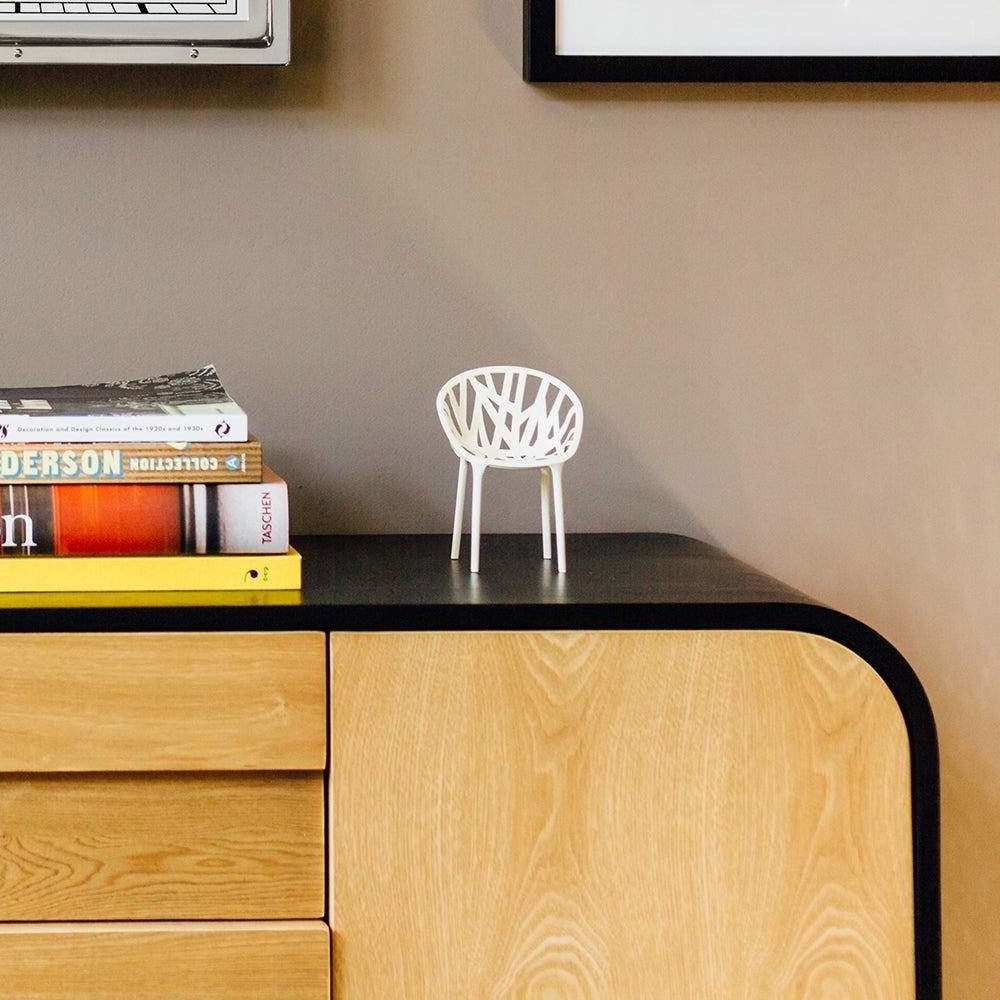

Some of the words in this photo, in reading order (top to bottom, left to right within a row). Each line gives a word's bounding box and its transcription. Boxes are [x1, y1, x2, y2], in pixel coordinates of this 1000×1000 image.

[70, 426, 94, 434] Design
[129, 456, 219, 472] COLLECTION
[261, 491, 273, 545] TASCHEN
